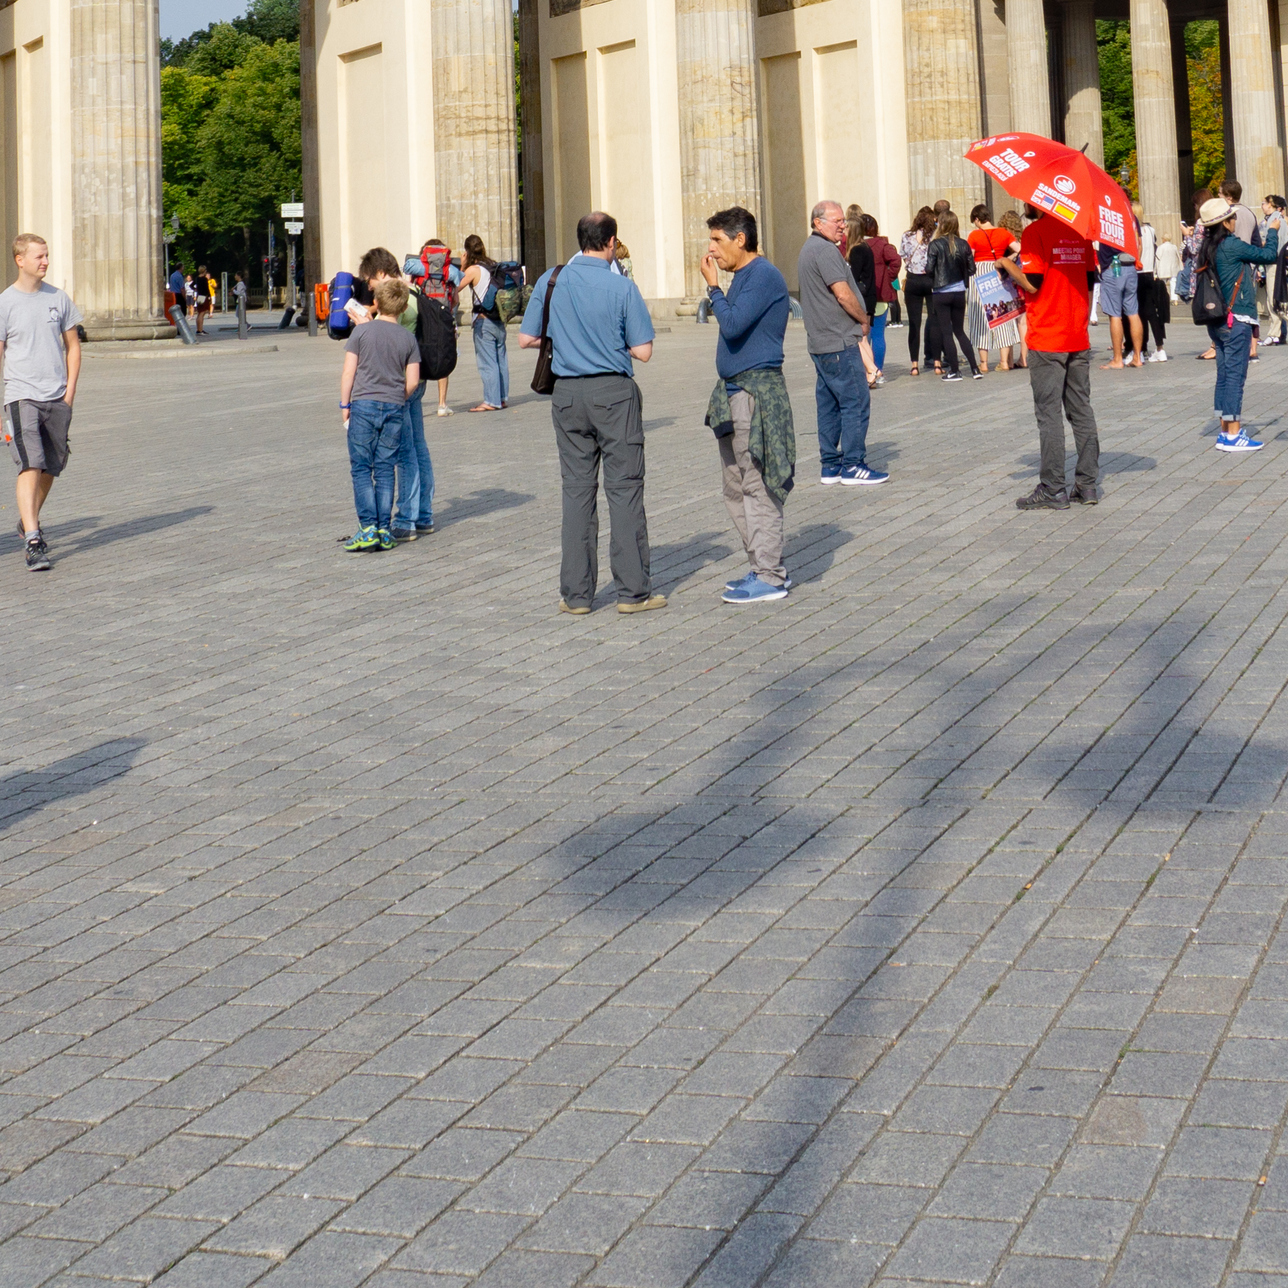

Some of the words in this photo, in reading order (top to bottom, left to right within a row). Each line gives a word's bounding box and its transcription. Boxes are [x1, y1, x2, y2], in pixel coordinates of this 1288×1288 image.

[989, 155, 1018, 178] GRATIS
[999, 147, 1030, 172] TOUR
[1098, 204, 1124, 228] FREE
[1099, 218, 1125, 242] TOUR
